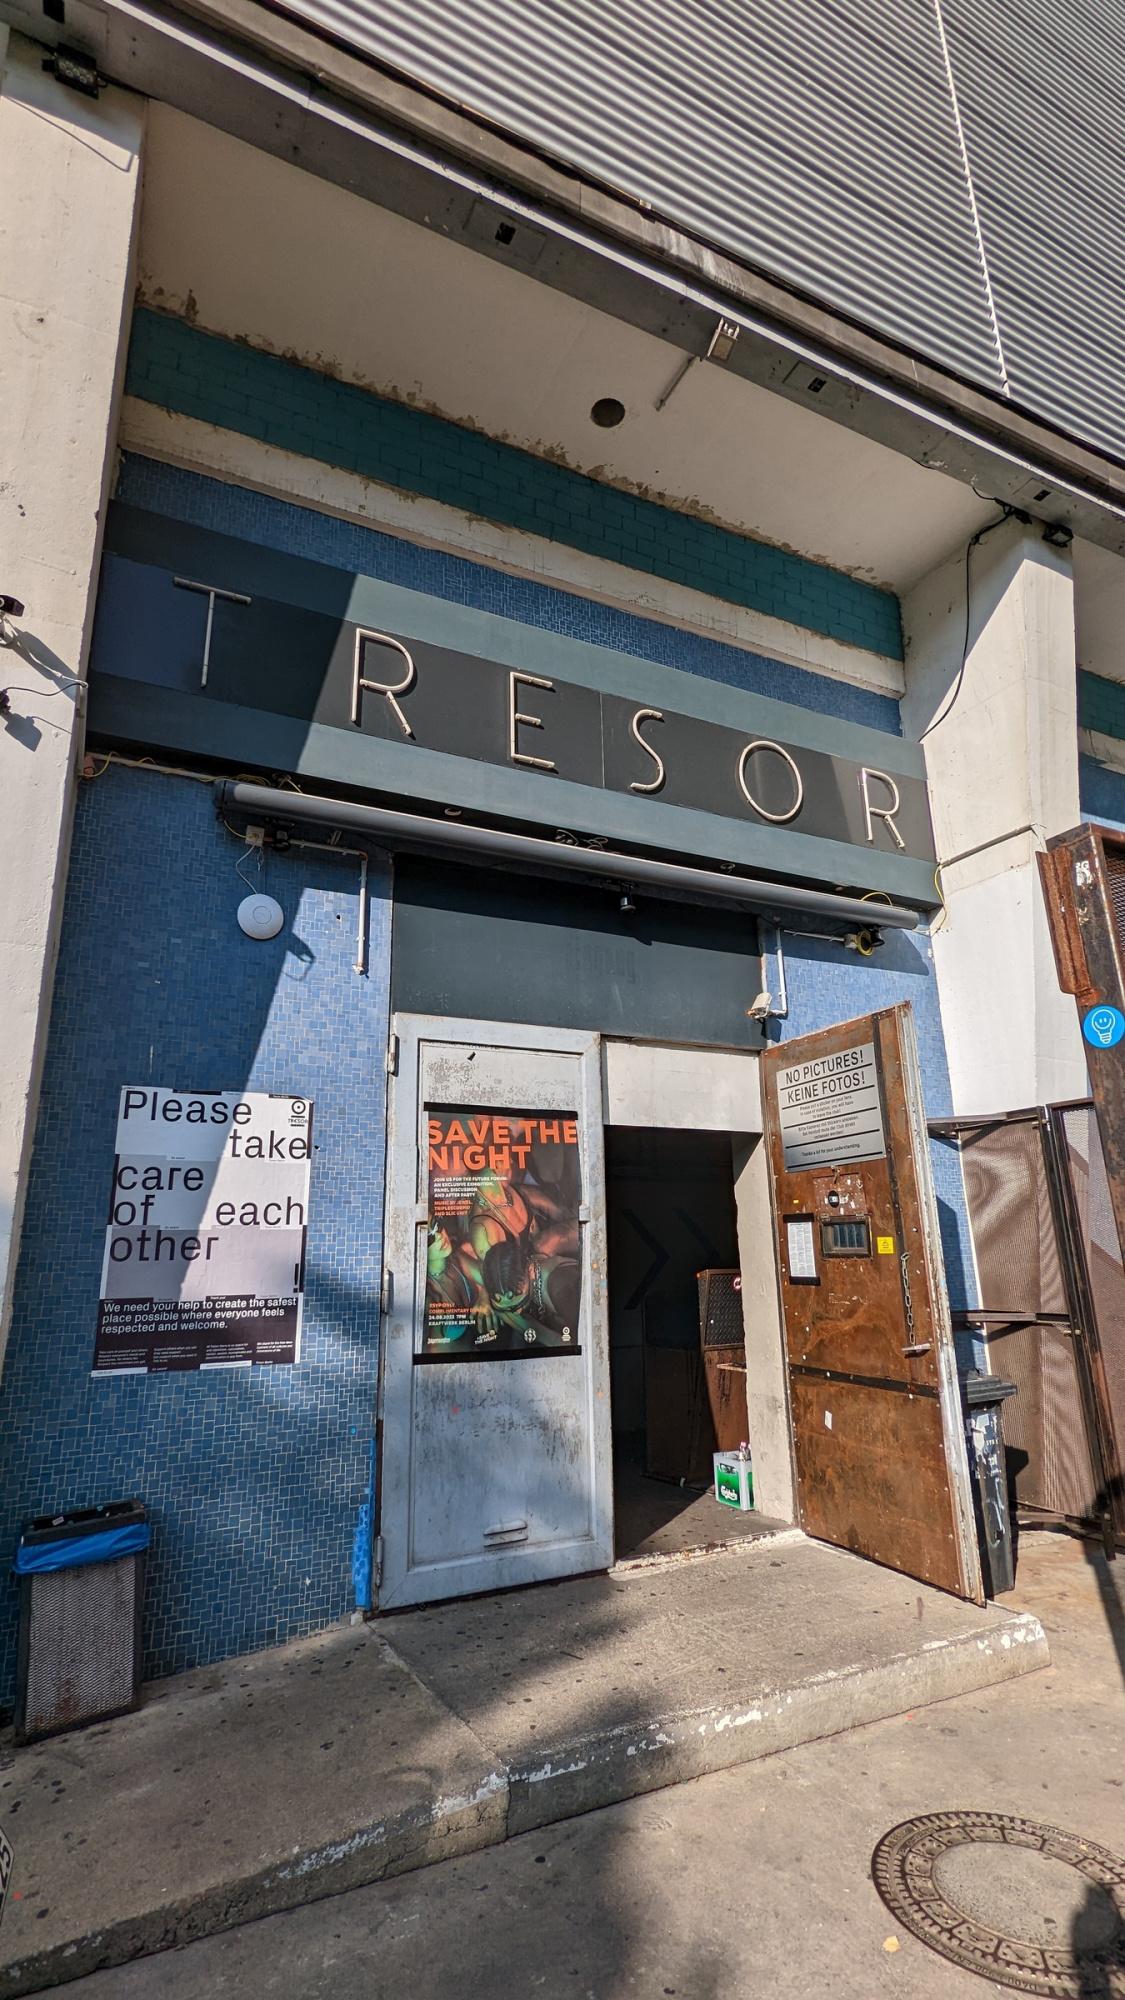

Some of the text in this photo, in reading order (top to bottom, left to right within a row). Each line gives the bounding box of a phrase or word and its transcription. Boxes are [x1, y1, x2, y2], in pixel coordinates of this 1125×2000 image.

[173, 576, 905, 849] TRESOR
[786, 1050, 864, 1084] NO PICTURES!
[788, 1071, 865, 1103] KEINE FOTOS!
[123, 1090, 251, 1125] Please
[229, 1129, 307, 1159] take
[429, 1120, 577, 1145] SAVE THE
[429, 1145, 531, 1171] NIGHT
[117, 1165, 204, 1191] care
[114, 1195, 304, 1226] of each
[109, 1229, 219, 1262] other
[103, 1308, 285, 1325] place possible where everyone feels
[104, 1297, 297, 1313] We need your help to create the safest
[101, 1320, 228, 1334] respected and welcome.
